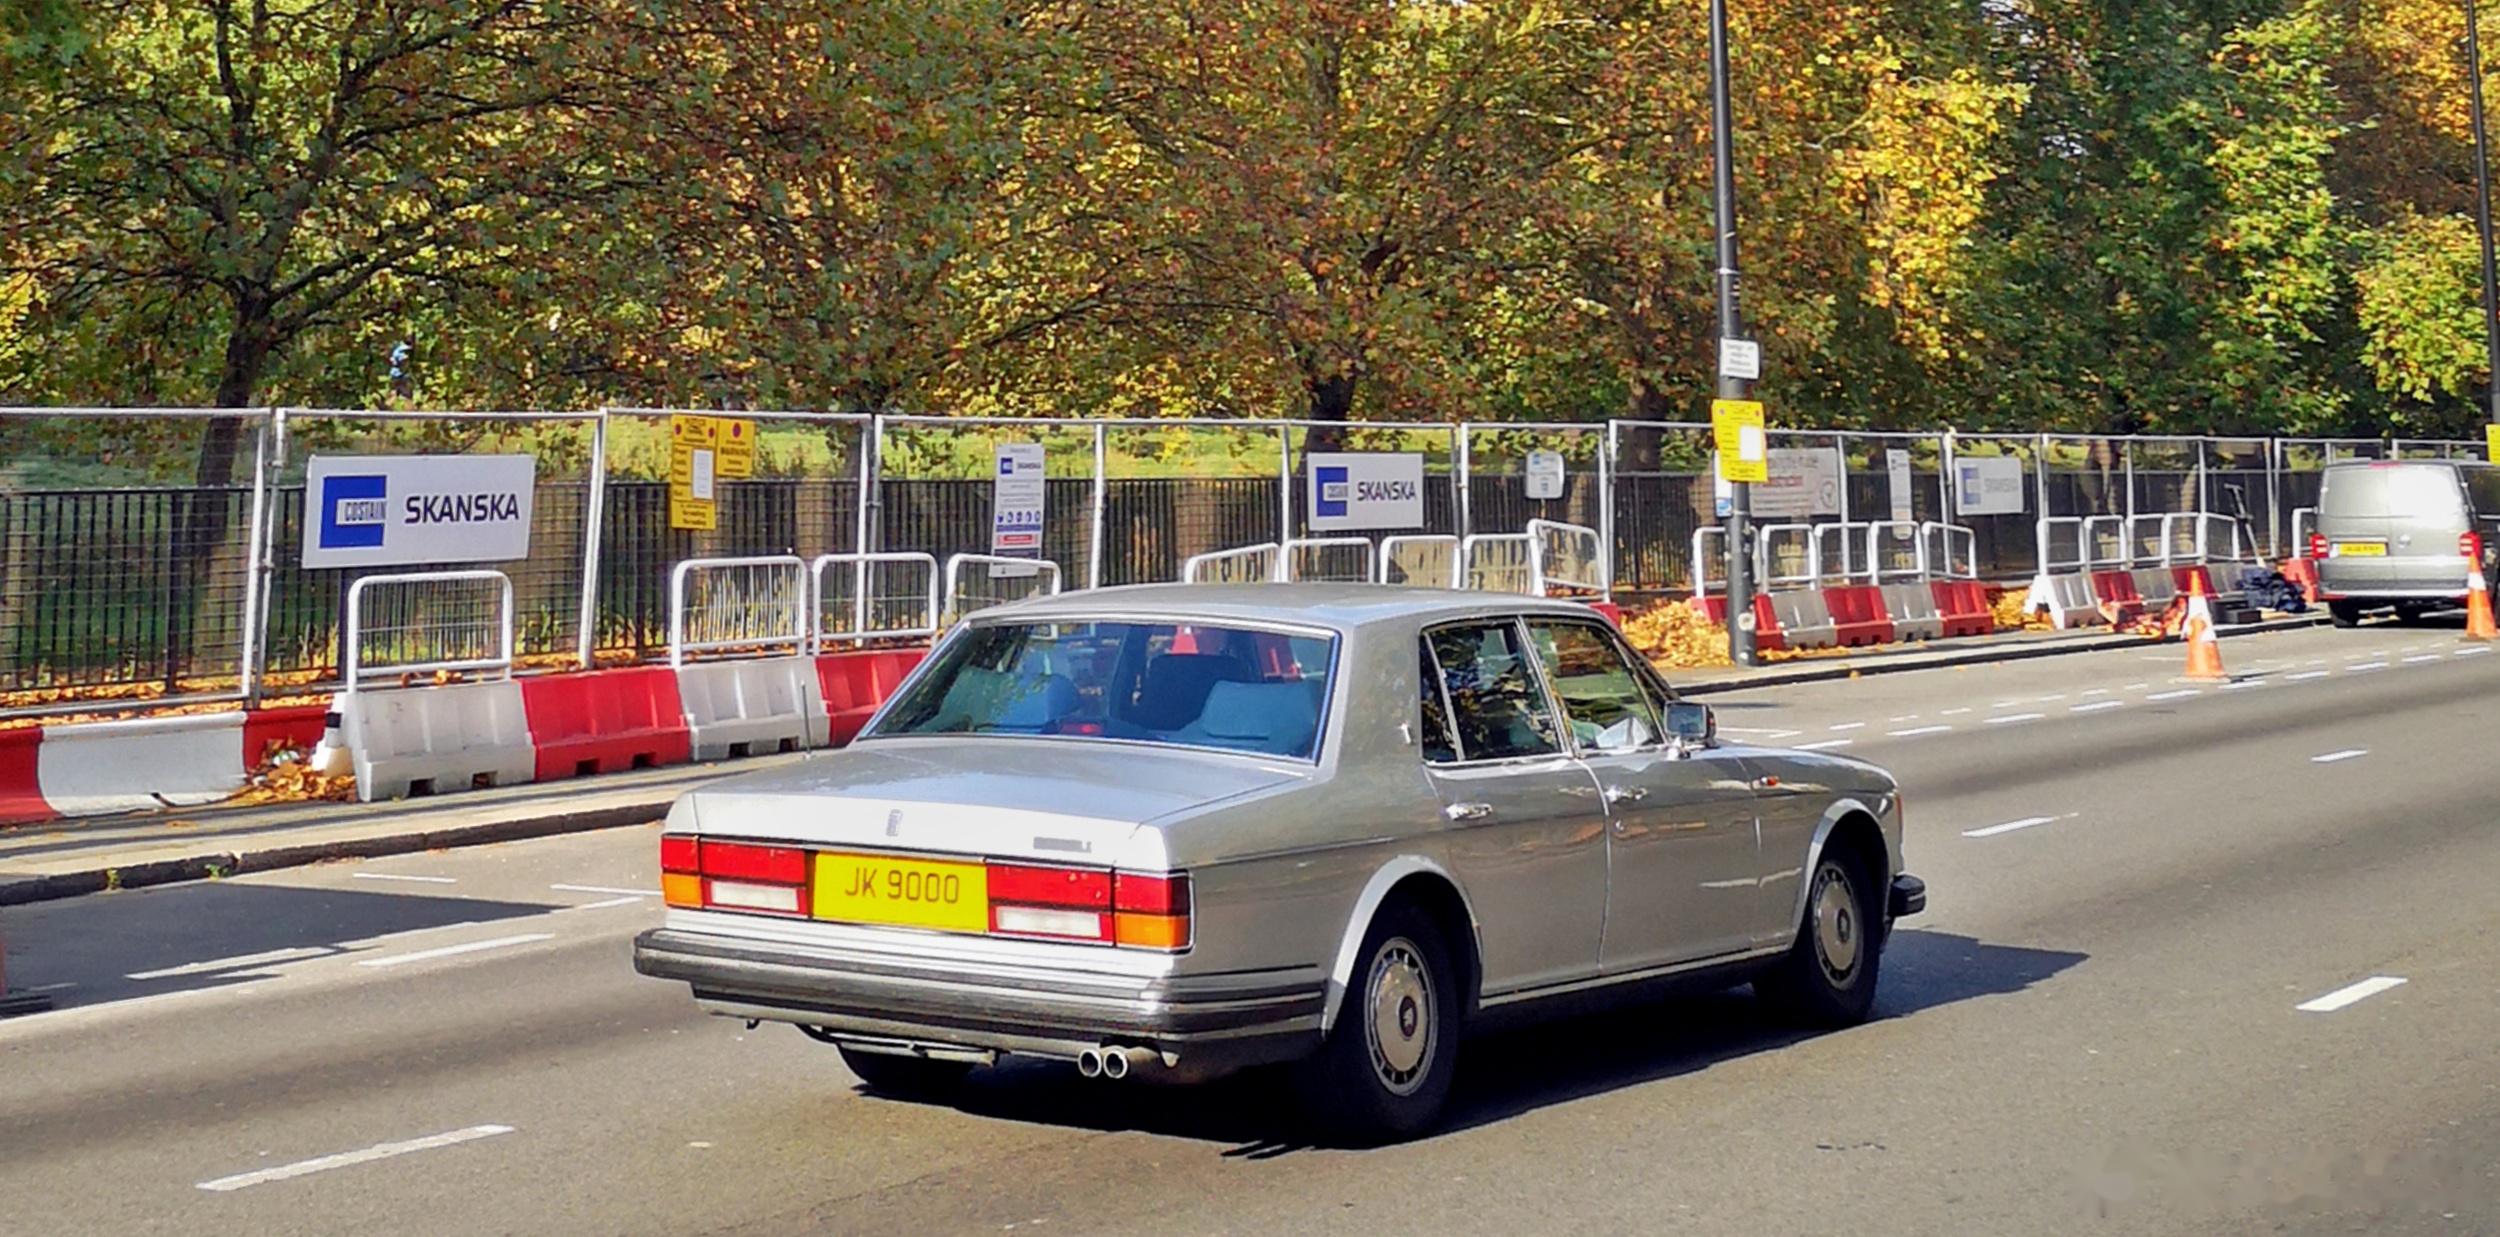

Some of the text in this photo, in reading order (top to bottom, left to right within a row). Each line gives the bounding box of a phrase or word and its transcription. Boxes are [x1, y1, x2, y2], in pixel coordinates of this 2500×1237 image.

[1357, 481, 1417, 502] SKANSKA
[405, 494, 519, 523] SKANSKA
[844, 866, 960, 904] JK 9000
